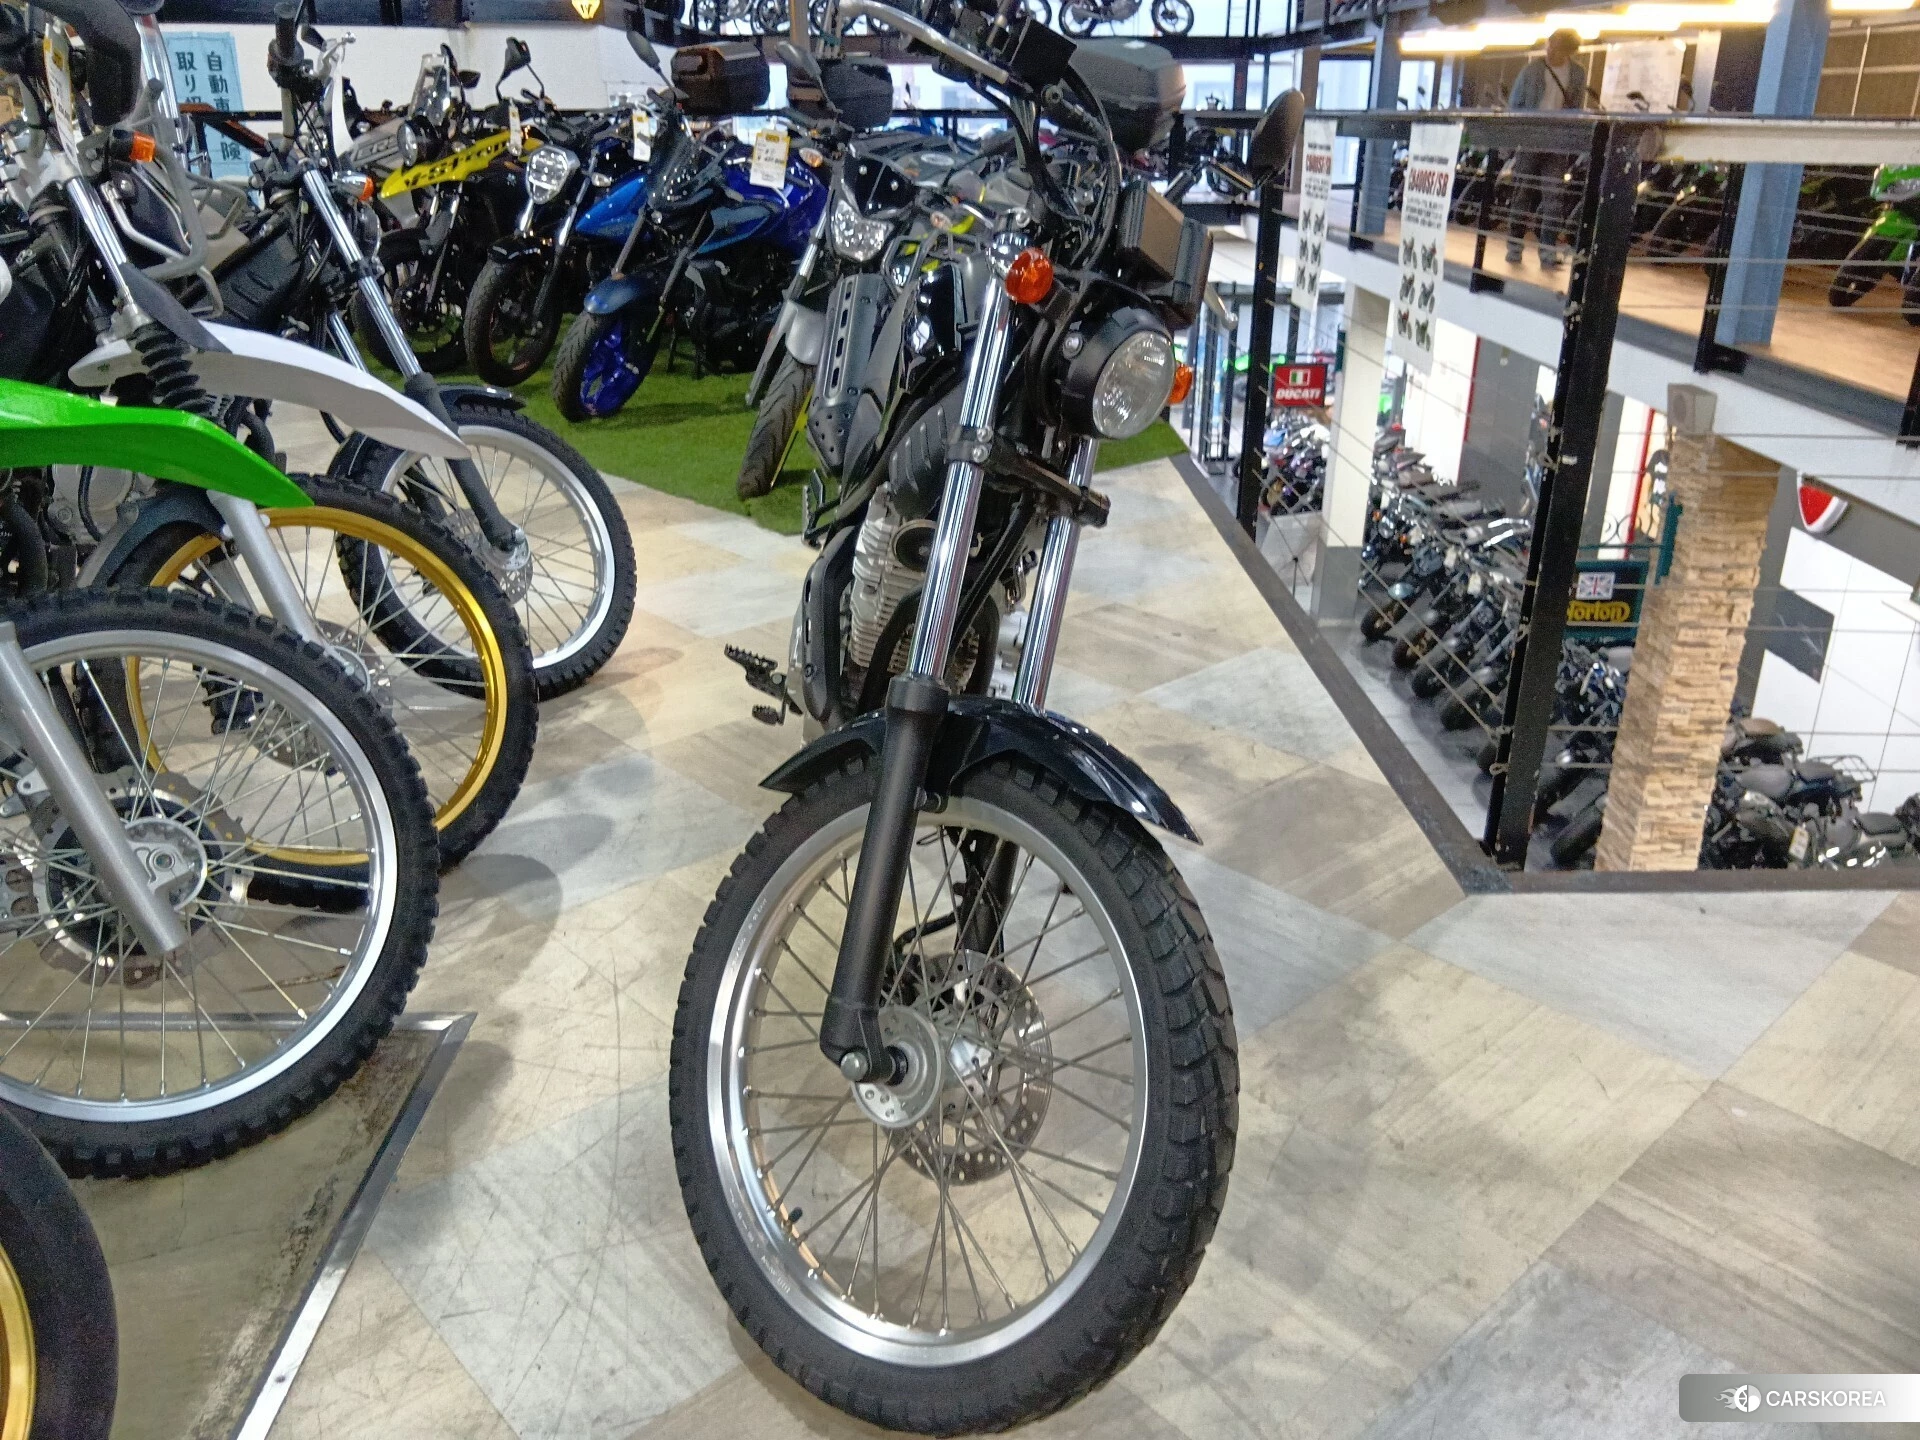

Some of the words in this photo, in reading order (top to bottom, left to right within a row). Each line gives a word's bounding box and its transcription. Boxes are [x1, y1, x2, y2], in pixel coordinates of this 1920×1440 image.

[207, 51, 242, 161] 自動車険
[1275, 387, 1321, 400] DUCATI
